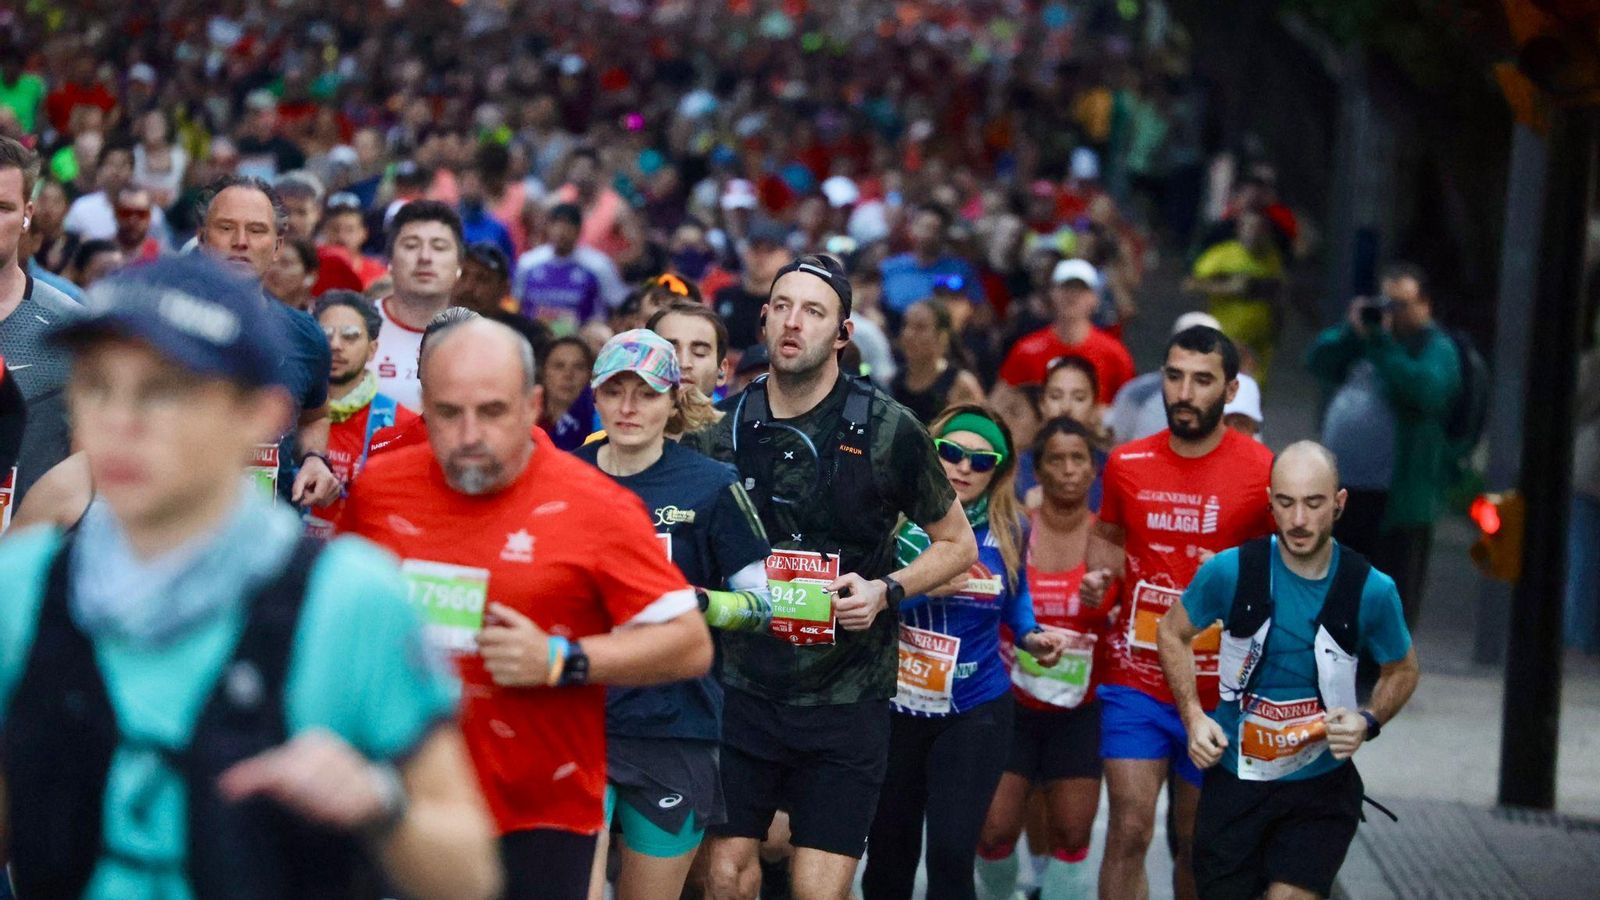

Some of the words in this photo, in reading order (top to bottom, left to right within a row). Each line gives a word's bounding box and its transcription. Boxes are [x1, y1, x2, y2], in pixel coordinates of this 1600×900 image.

[839, 444, 863, 455] KIPRUN
[766, 554, 831, 574] GENERALI
[771, 585, 808, 606] 942
[800, 626, 819, 634] 42K
[1261, 702, 1320, 721] GENERALI
